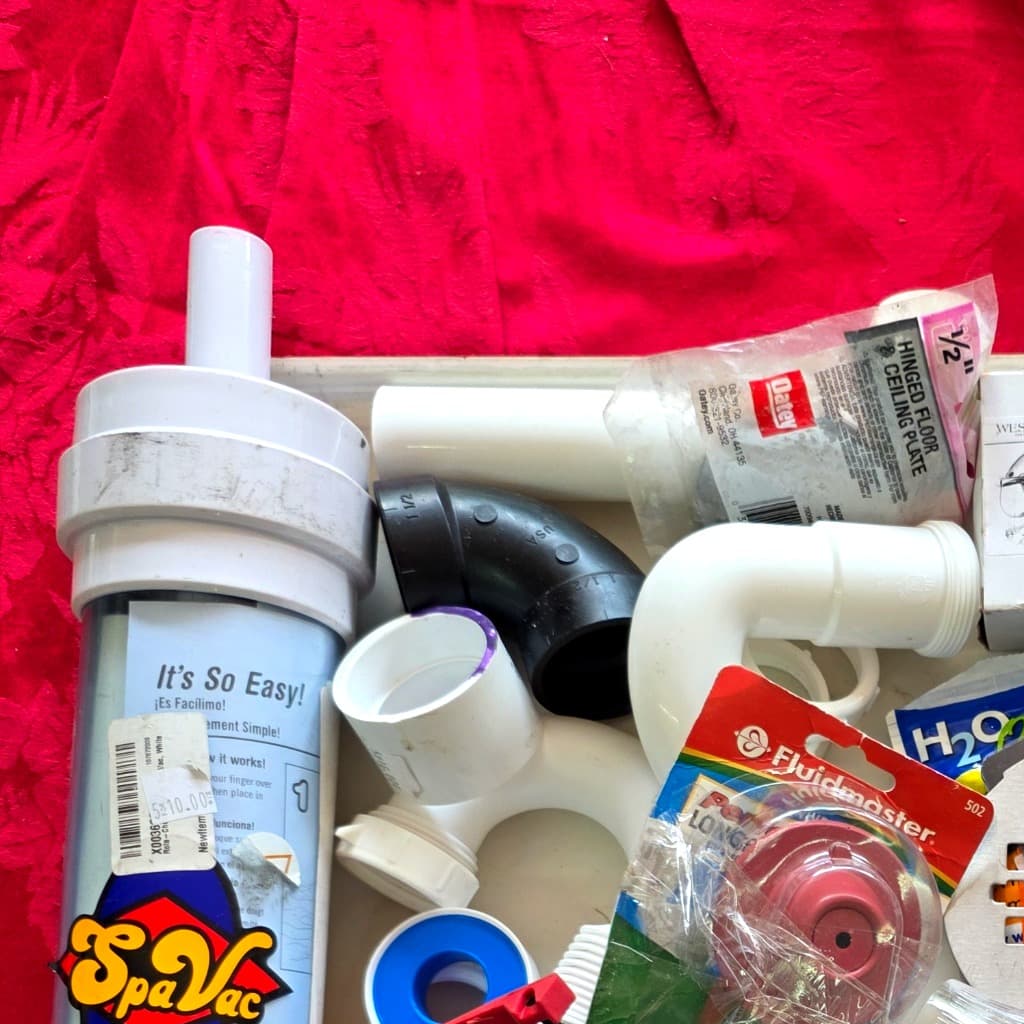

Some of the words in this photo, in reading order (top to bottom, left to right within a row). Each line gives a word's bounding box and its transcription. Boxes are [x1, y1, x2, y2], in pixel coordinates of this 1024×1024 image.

[695, 388, 715, 435] Oatey.com
[765, 375, 801, 432] Oatey
[895, 339, 926, 404] HINGED
[913, 406, 939, 455] FLOOR
[883, 361, 915, 430] CEILING
[901, 429, 927, 477] PLATE
[526, 525, 556, 545] USA
[156, 664, 195, 690] It's
[204, 666, 235, 692] So
[245, 671, 305, 709] Easy!
[242, 723, 281, 739] Simple!
[219, 754, 228, 767] it
[230, 754, 266, 769] works!
[229, 774, 253, 788] finger
[255, 779, 272, 789] over
[231, 788, 253, 801] place
[255, 790, 264, 800] in
[771, 744, 936, 845] Fluidmaster
[963, 799, 986, 818] 502
